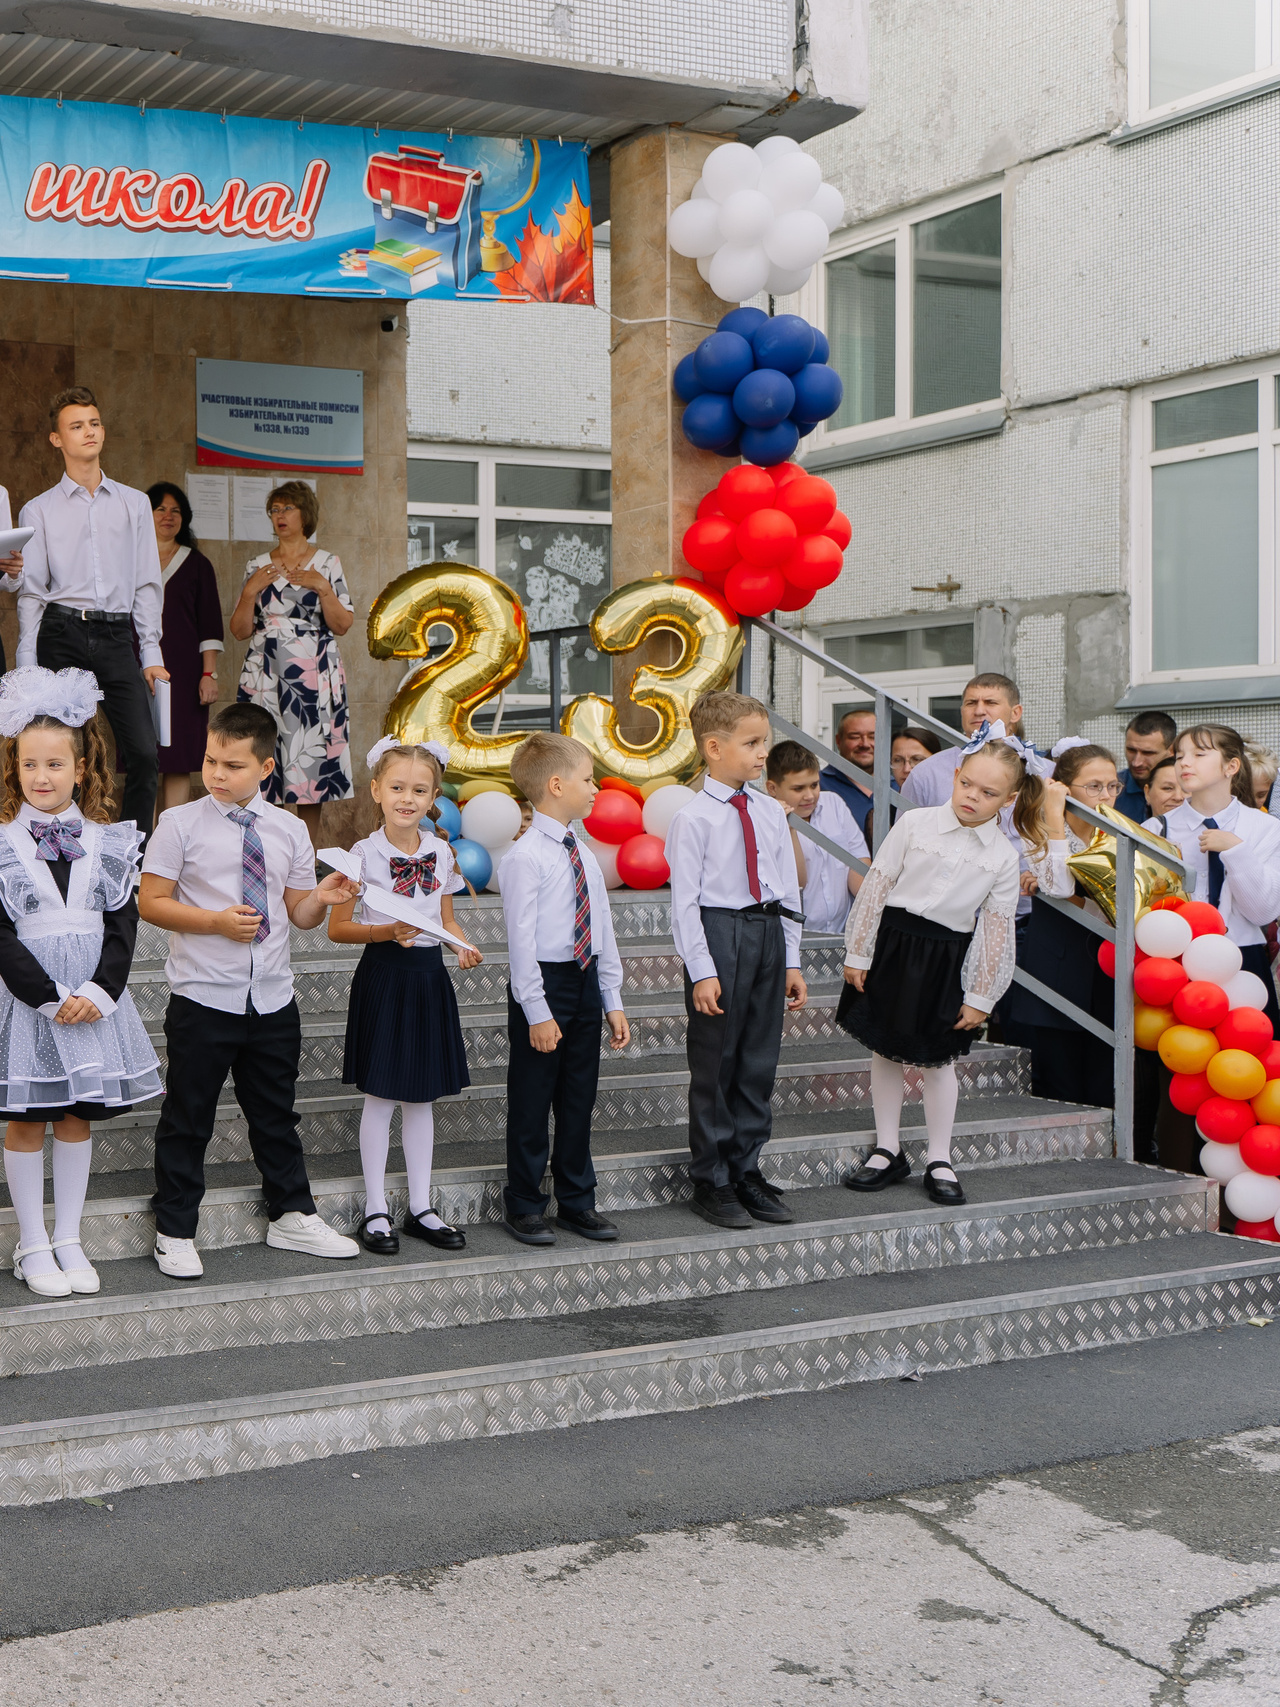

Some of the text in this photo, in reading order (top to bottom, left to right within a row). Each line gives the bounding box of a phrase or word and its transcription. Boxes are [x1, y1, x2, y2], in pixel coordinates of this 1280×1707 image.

[25, 158, 330, 242] школа!
[201, 393, 360, 414] УЧАСТКОВЫЕ ИЗБИРАТЕЛЬНЫЕ КОМИССИИ
[229, 408, 333, 424] ИЗБИРАТЕЛЬНЫХ УЧАСТКОВ
[254, 423, 310, 435] №1338, №1339
